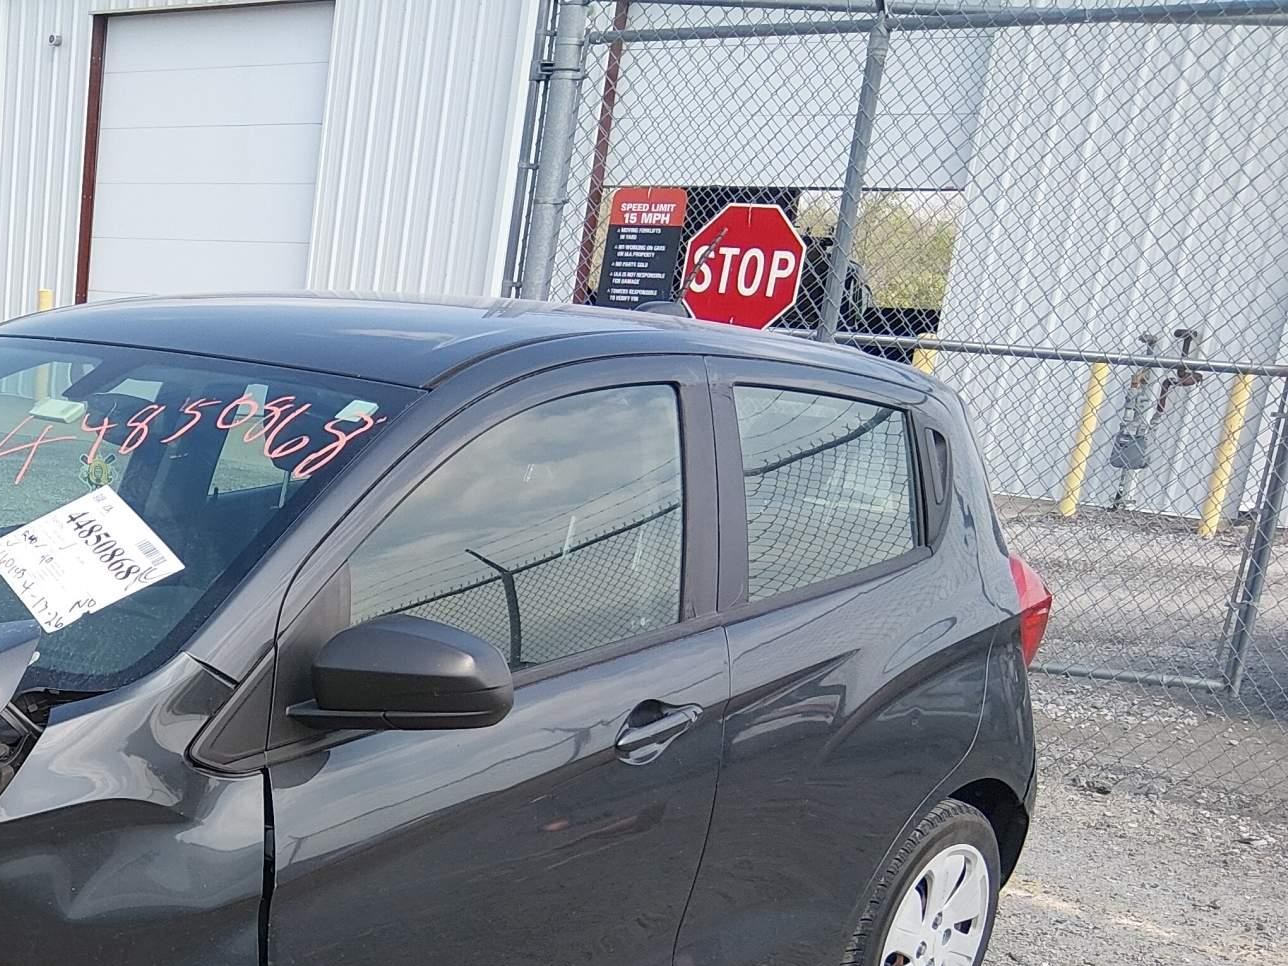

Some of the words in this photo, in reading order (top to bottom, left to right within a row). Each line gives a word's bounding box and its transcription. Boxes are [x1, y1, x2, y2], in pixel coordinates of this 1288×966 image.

[620, 202, 650, 212] SPEED
[651, 203, 677, 212] LIMIT
[623, 212, 638, 224] 15
[640, 212, 671, 225] MPH
[690, 245, 796, 298] STOP
[66, 511, 140, 581] 44850868
